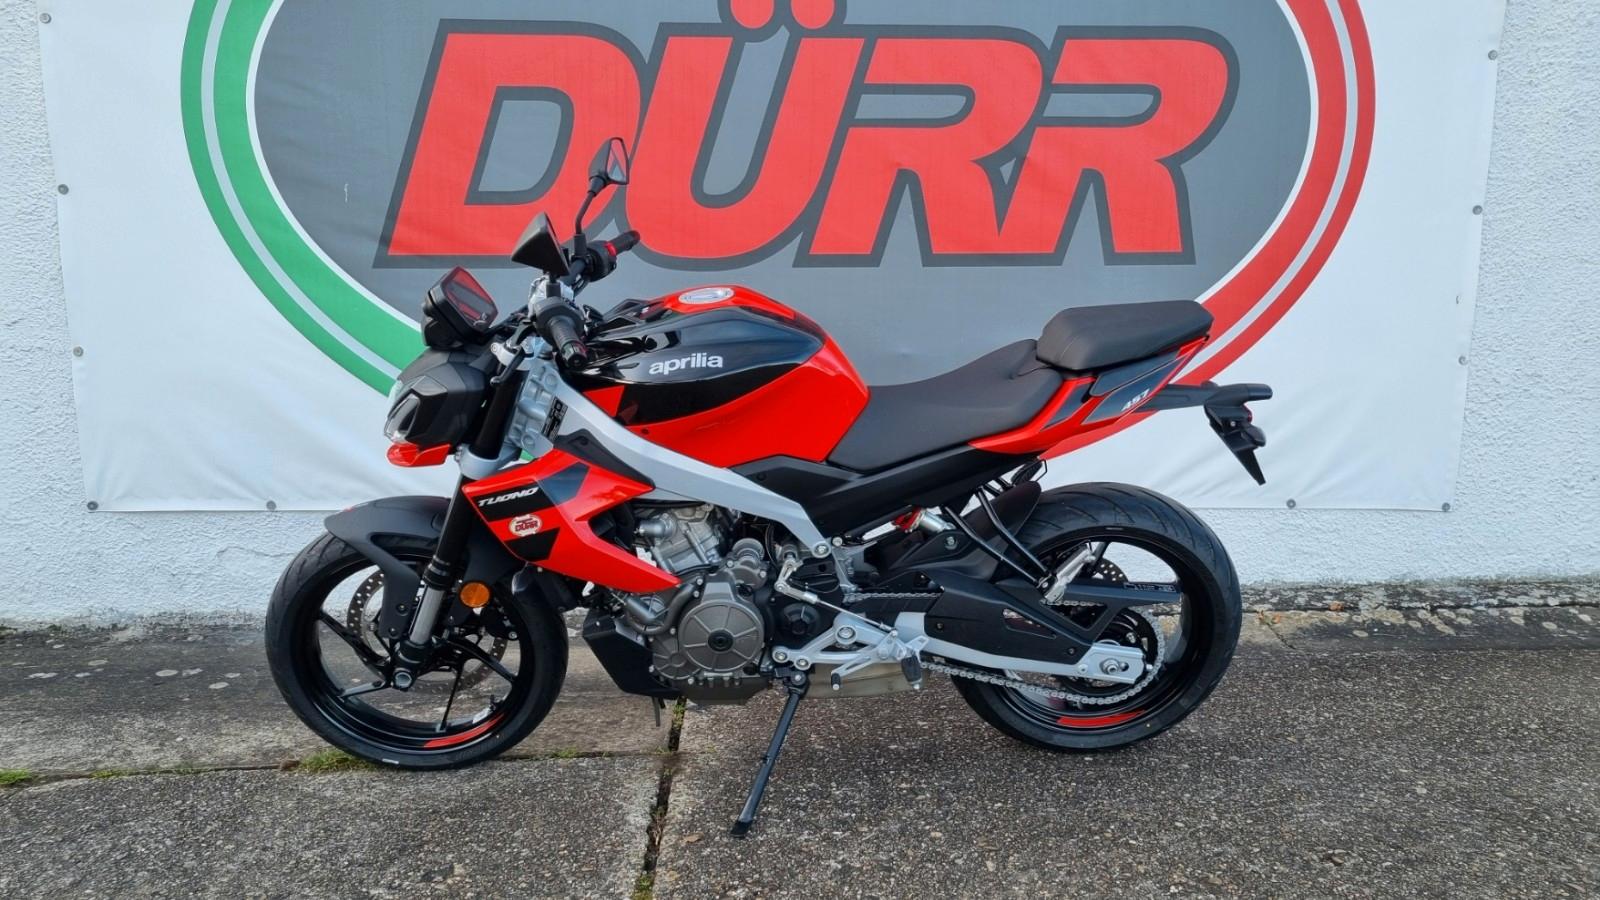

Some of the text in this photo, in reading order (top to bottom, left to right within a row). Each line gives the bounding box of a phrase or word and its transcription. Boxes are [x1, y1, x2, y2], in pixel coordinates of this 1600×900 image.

[383, 0, 1233, 263] DÜRR
[648, 352, 724, 375] aprilia
[1120, 388, 1150, 411] 457
[478, 486, 539, 507] TUONO
